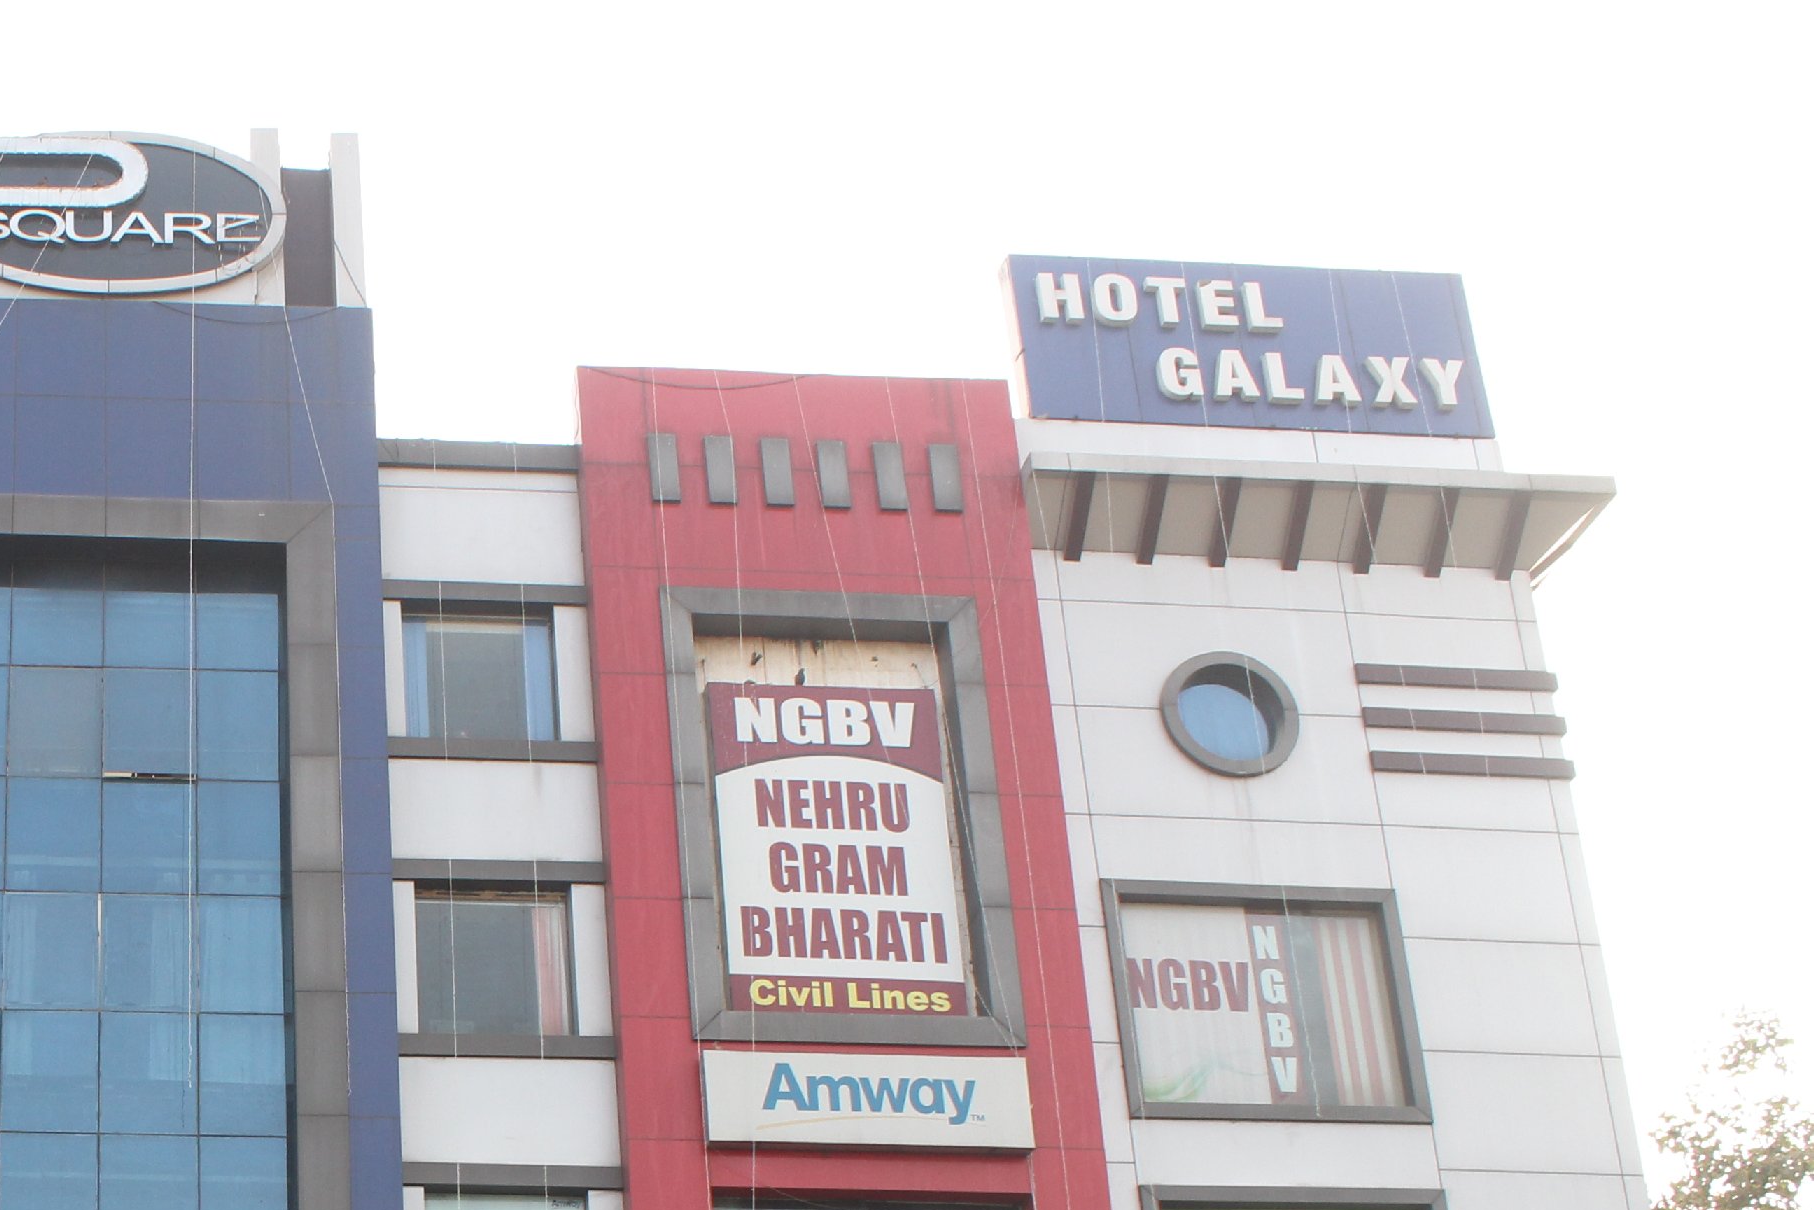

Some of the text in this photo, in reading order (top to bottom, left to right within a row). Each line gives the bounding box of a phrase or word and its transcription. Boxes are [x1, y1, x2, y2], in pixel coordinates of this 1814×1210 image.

[1036, 272, 1283, 333] HOTEL
[1156, 347, 1463, 411] GALAXY
[734, 697, 914, 748] NGBV
[754, 778, 910, 832] NEHRU
[769, 841, 908, 896] GRAM
[740, 906, 948, 964] BHARATI
[749, 980, 951, 1012] Civil Lines
[1126, 958, 1248, 1012] NGBV
[1252, 925, 1298, 1093] NGBV
[762, 1062, 976, 1125] Amway
